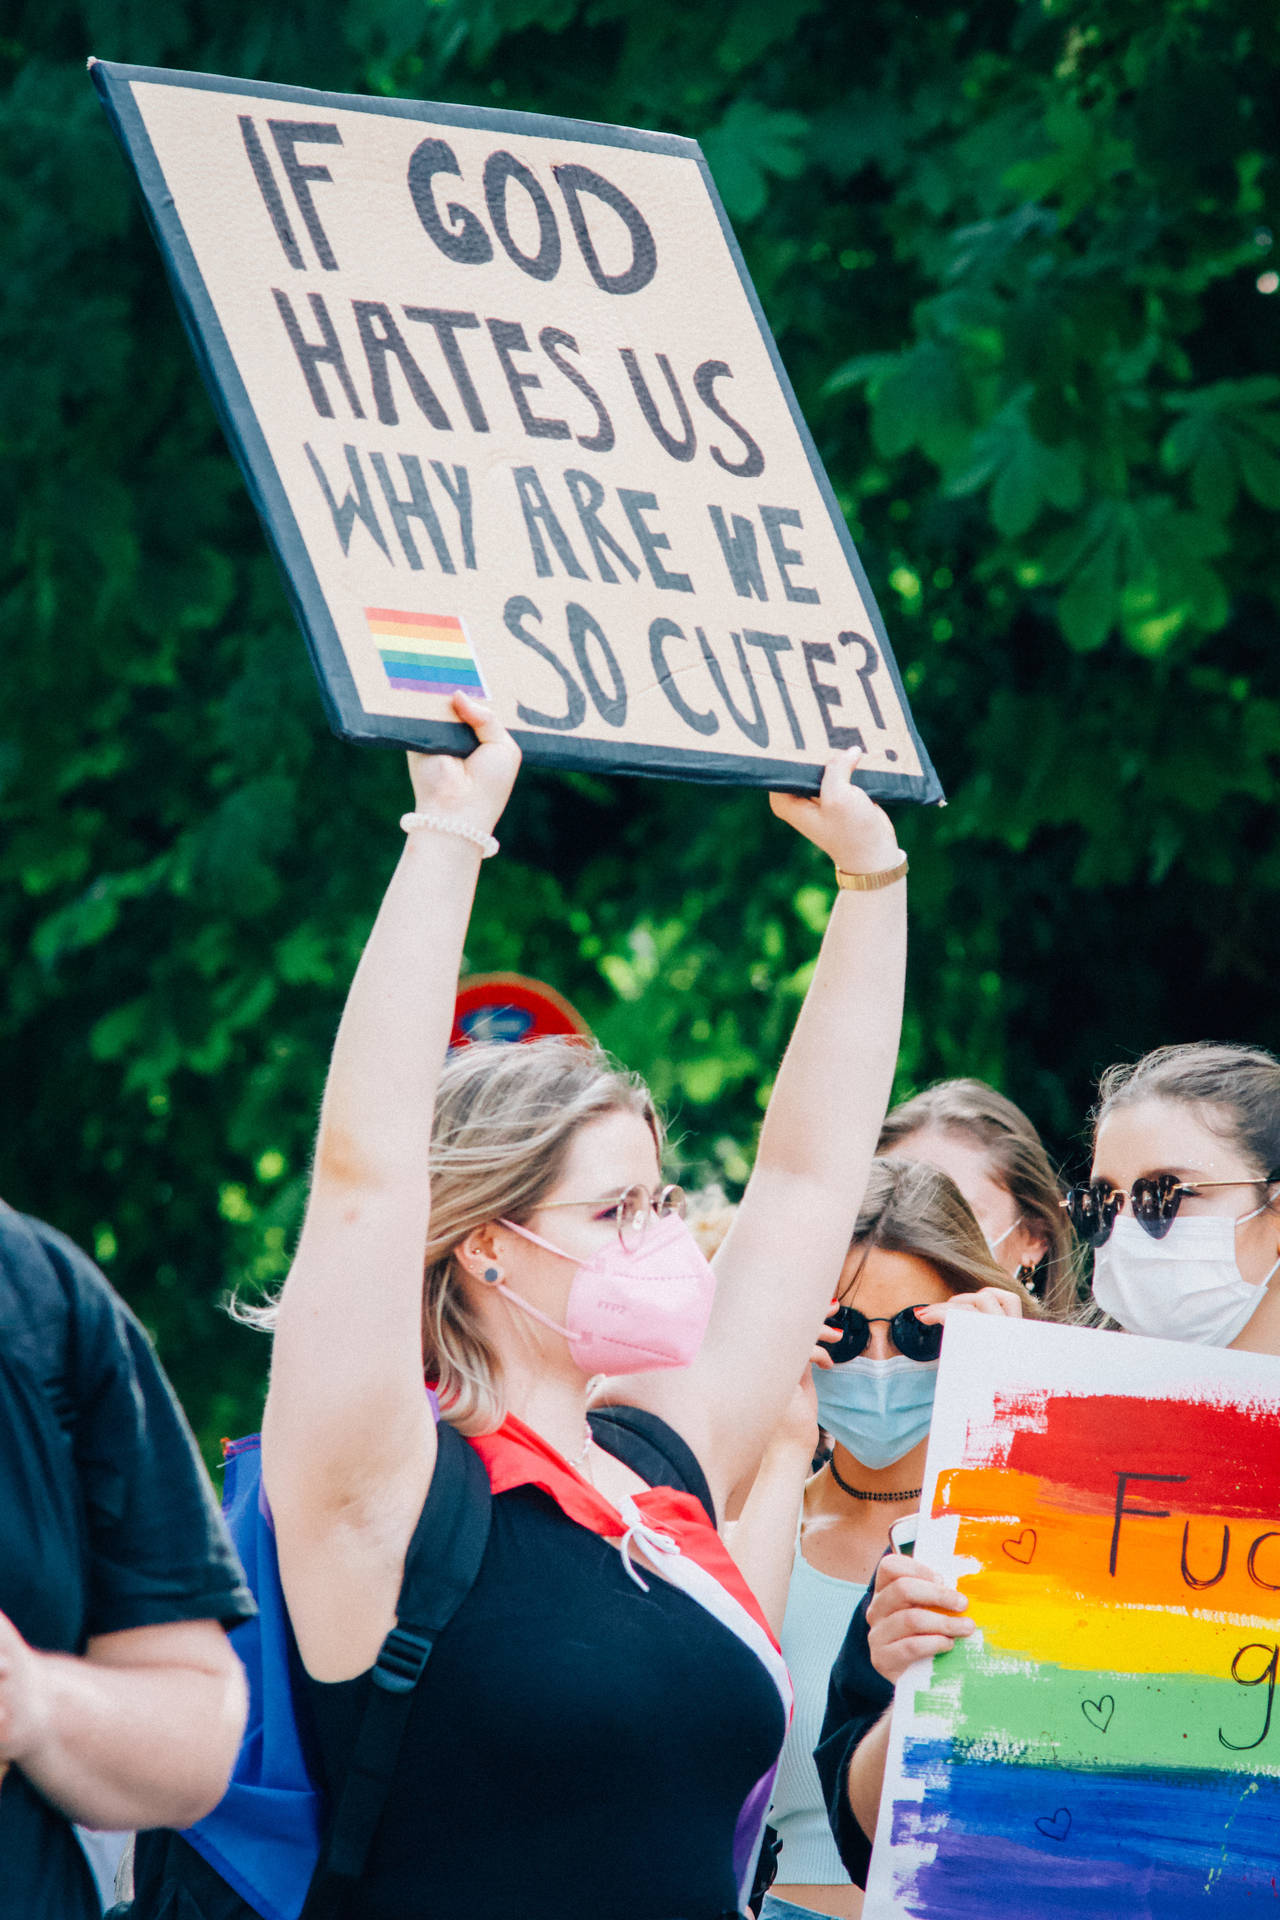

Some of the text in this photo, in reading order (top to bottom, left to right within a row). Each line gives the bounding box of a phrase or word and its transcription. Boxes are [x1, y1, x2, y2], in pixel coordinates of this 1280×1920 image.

[238, 115, 657, 295] IF GOD
[272, 288, 765, 477] HATES US
[304, 442, 822, 605] WHY ARE WE
[503, 595, 898, 762] SO CUTE?
